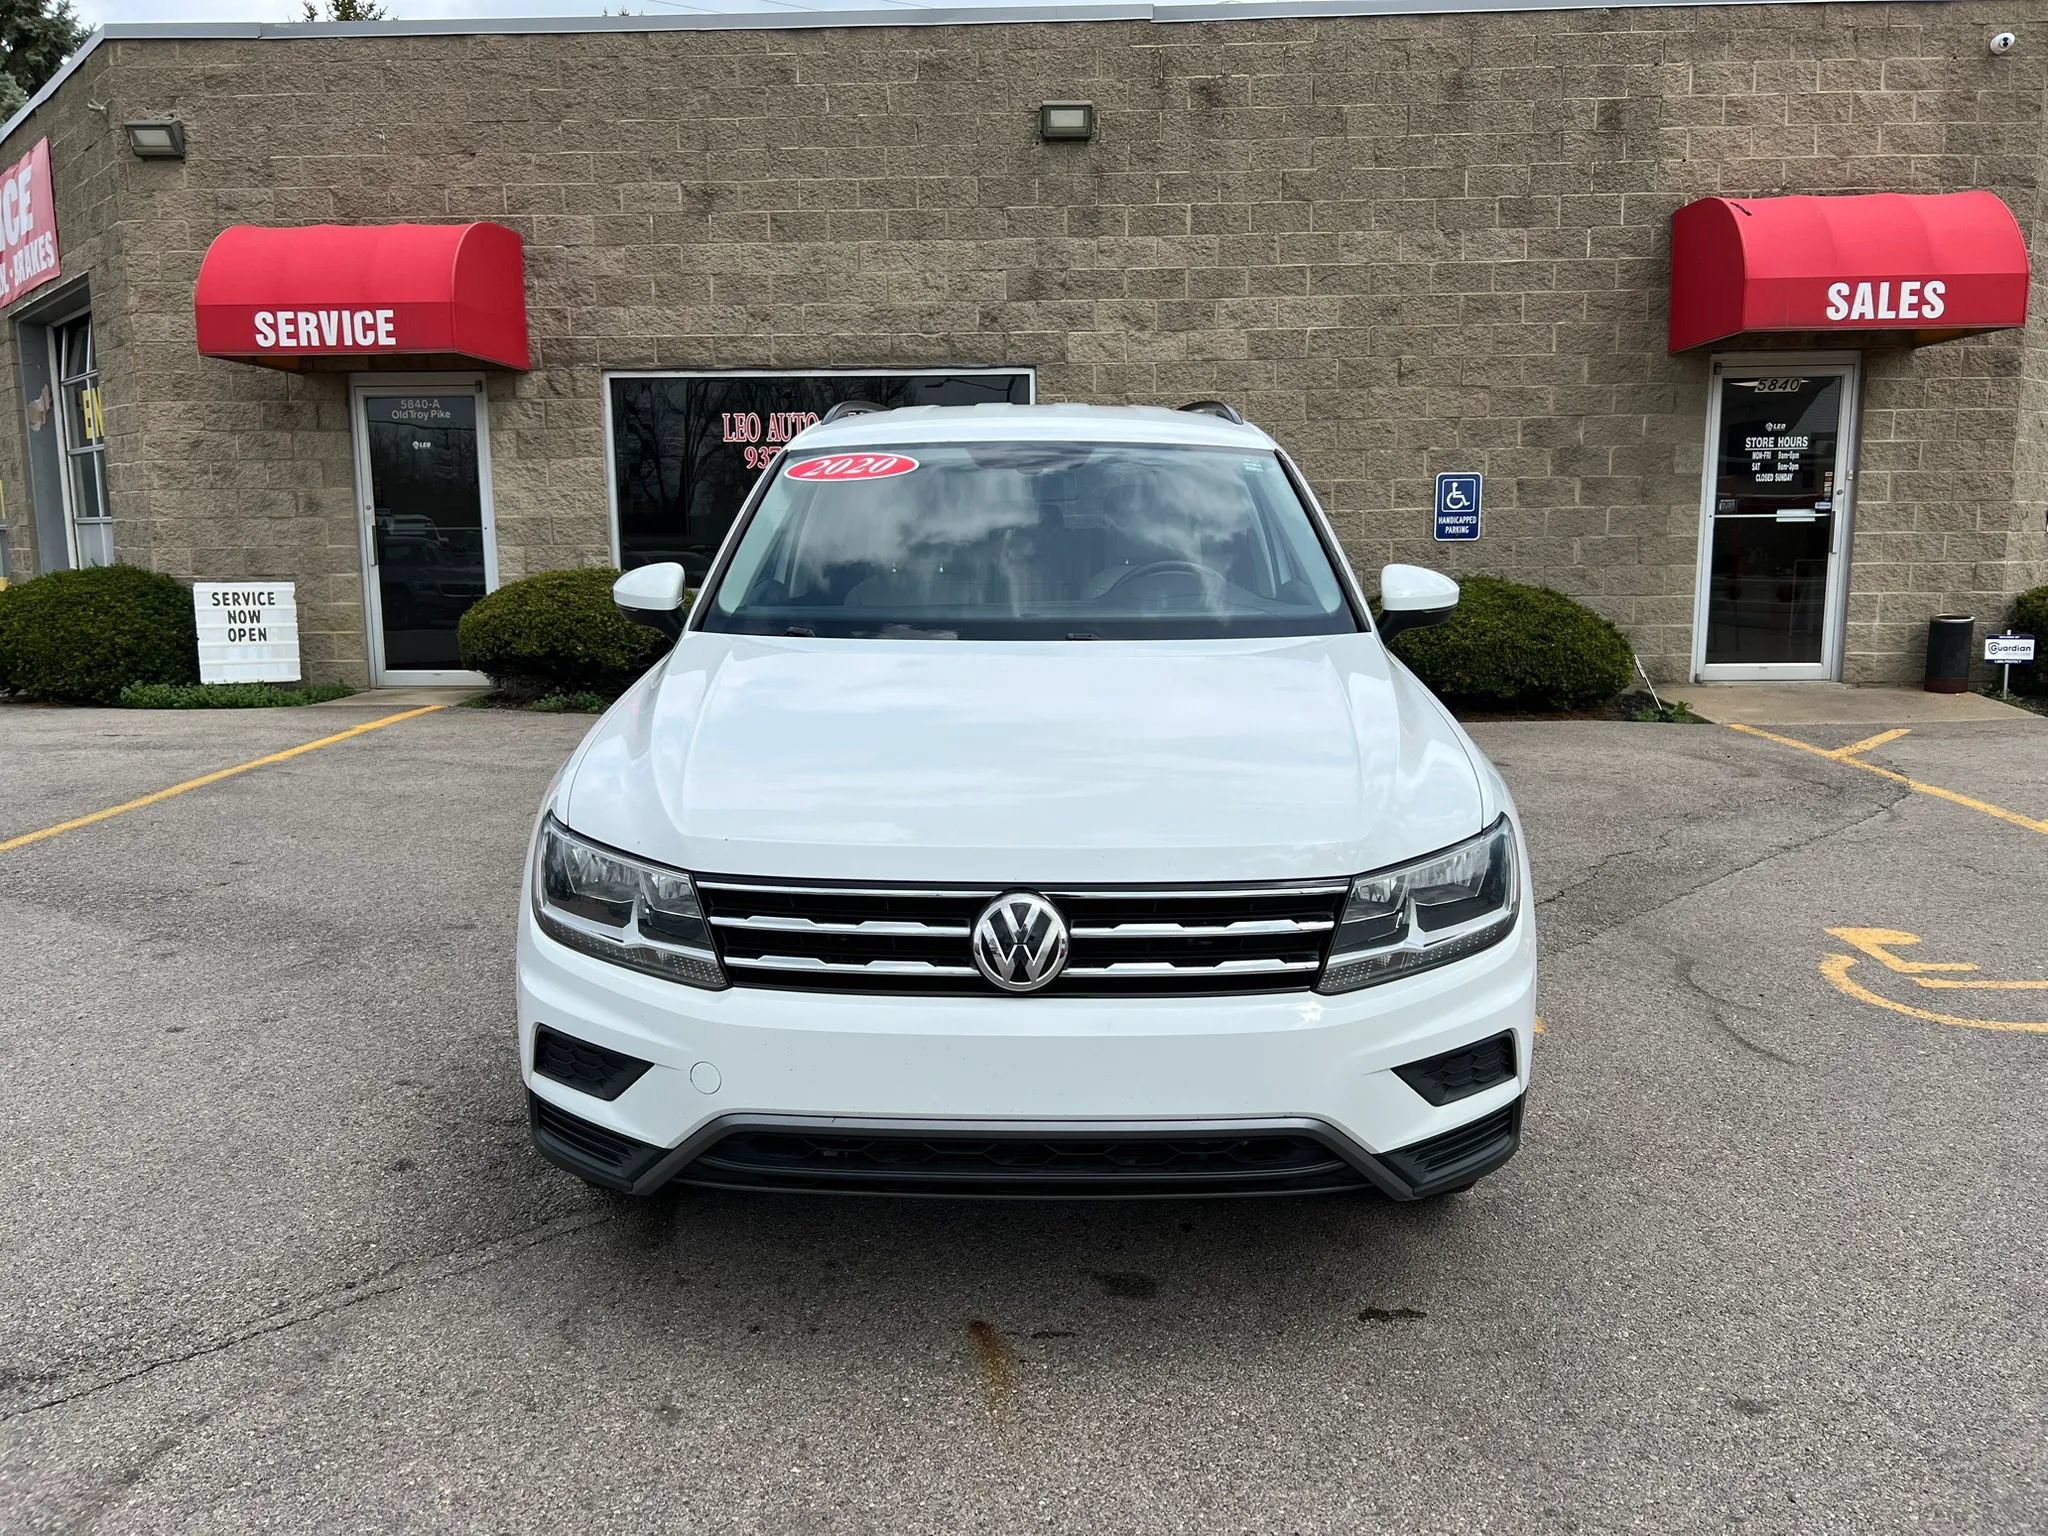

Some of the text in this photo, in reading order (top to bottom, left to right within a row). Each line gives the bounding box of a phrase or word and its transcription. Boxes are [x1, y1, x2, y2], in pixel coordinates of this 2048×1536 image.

[13, 231, 55, 287] BRAKES
[1826, 280, 1946, 321] SALES
[254, 309, 397, 348] SERVICE
[1756, 378, 1800, 391] 5840
[400, 399, 441, 409] 5840-A
[430, 410, 451, 419] Pike
[722, 412, 762, 443] LEO
[1745, 436, 1808, 448] STORE HOURS
[800, 456, 898, 477] 2020
[1751, 462, 1761, 471] SAT
[1755, 473, 1793, 482] CLOSED SUNDAY
[1438, 516, 1477, 525] HANDICAPPED
[1445, 526, 1470, 534] PARKING
[211, 591, 276, 606] SERVICE
[227, 609, 261, 624] NOW
[227, 627, 268, 642] OPEN
[1989, 644, 2032, 652] Guardian
[973, 893, 1068, 991] VW
